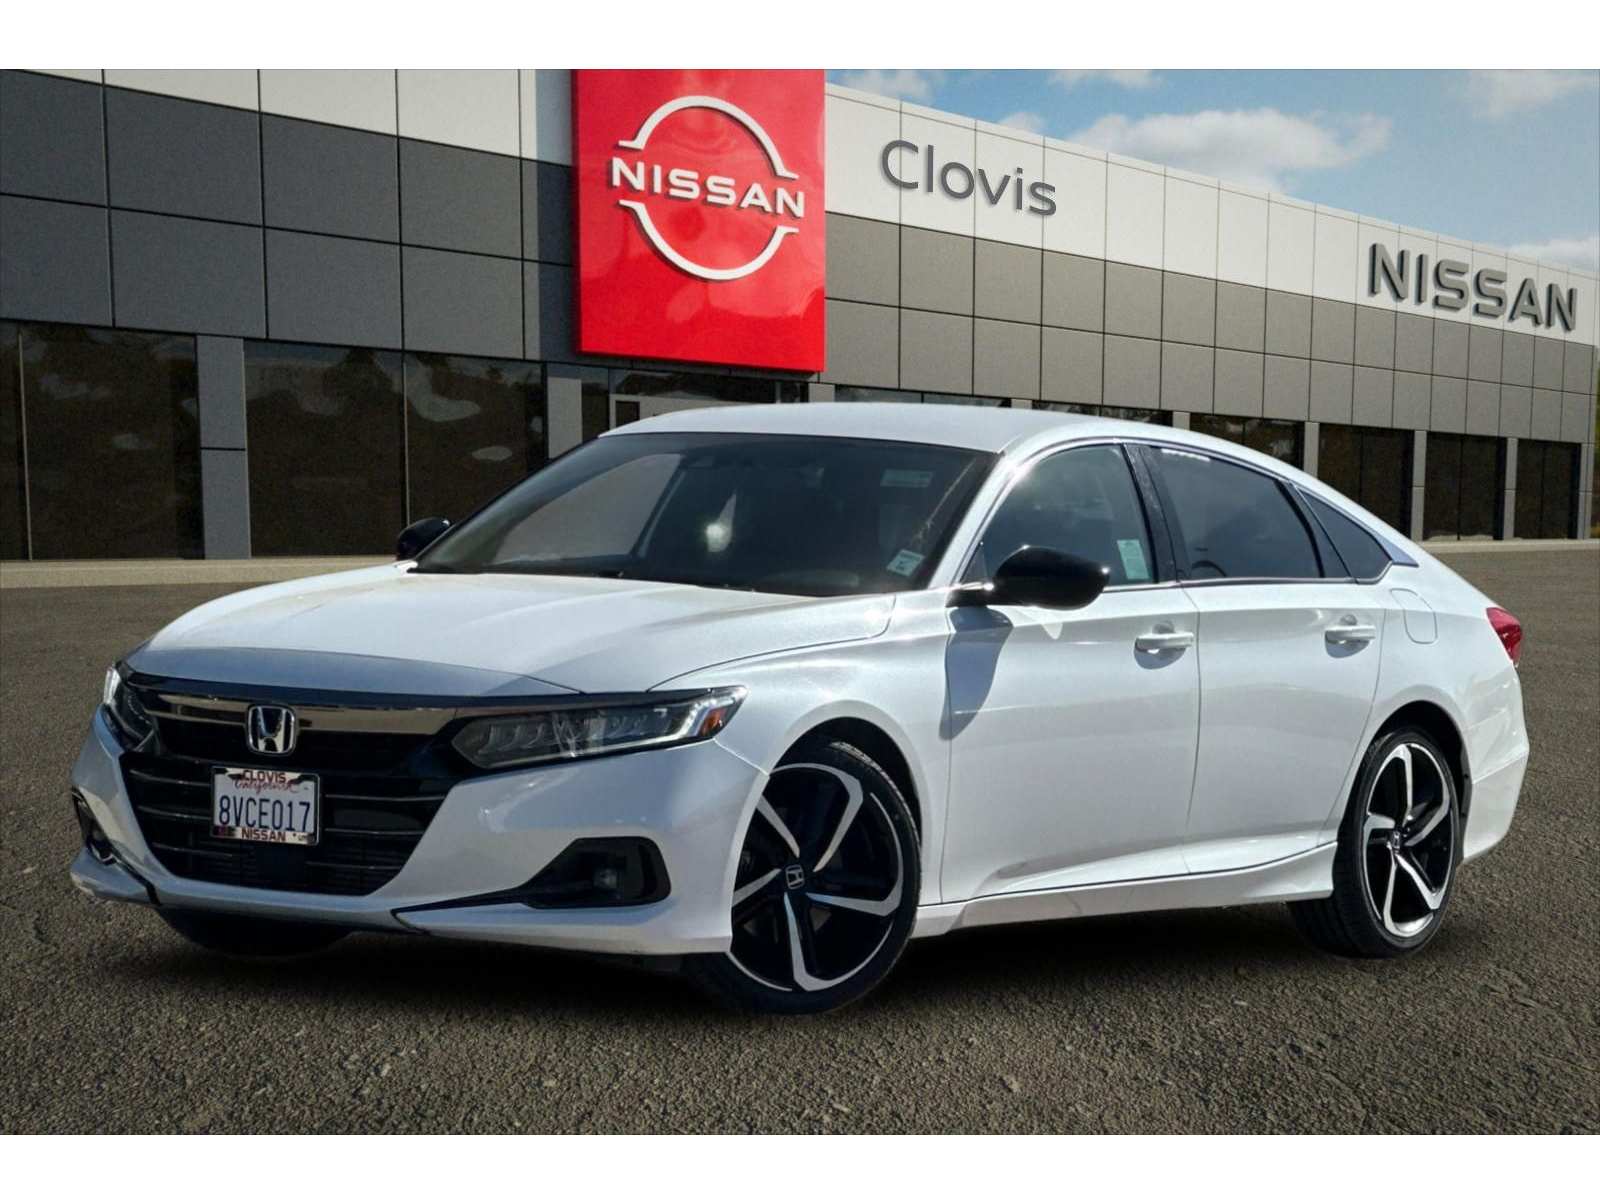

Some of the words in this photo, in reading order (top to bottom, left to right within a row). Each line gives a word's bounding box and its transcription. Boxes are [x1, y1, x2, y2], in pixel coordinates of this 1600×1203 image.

[611, 157, 805, 218] NISSAN
[882, 140, 1057, 216] Clovis
[1368, 243, 1577, 331] NISSAN
[243, 770, 287, 784] CLOVIS
[219, 795, 311, 832] 8VCE017
[241, 828, 286, 842] NISSAN
